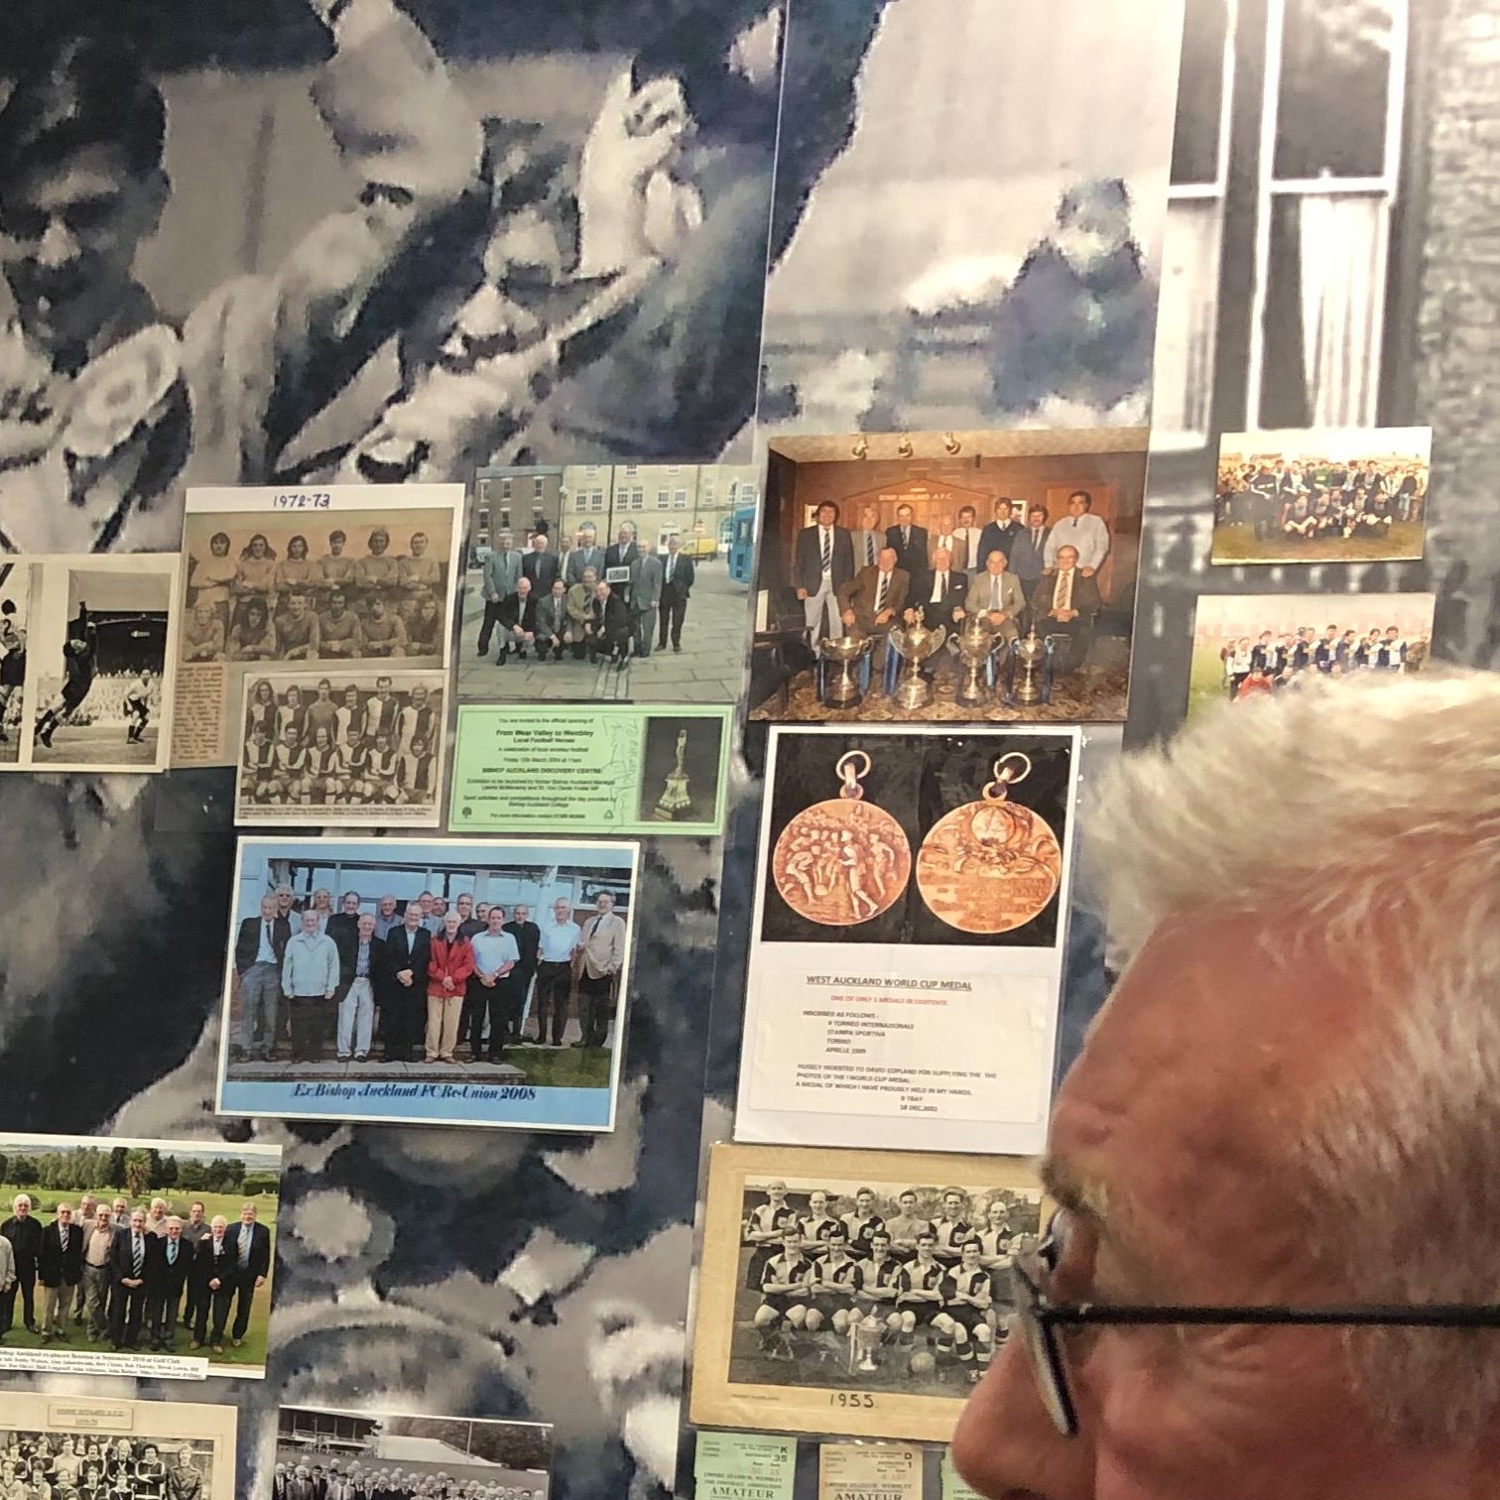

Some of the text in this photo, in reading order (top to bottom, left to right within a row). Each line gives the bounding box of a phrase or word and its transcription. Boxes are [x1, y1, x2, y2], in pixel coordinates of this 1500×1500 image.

[273, 494, 331, 508] 1972-73
[3, 619, 13, 636] 2
[806, 976, 973, 991] WEST AUCKLAND WORLD CUP MEDAL
[316, 1084, 355, 1099] Bishop
[358, 1084, 419, 1098] Auckland
[421, 1086, 440, 1098] FC
[500, 1087, 537, 1100] 2008
[904, 1452, 913, 1460] D
[710, 1486, 774, 1499] AMATEUR
